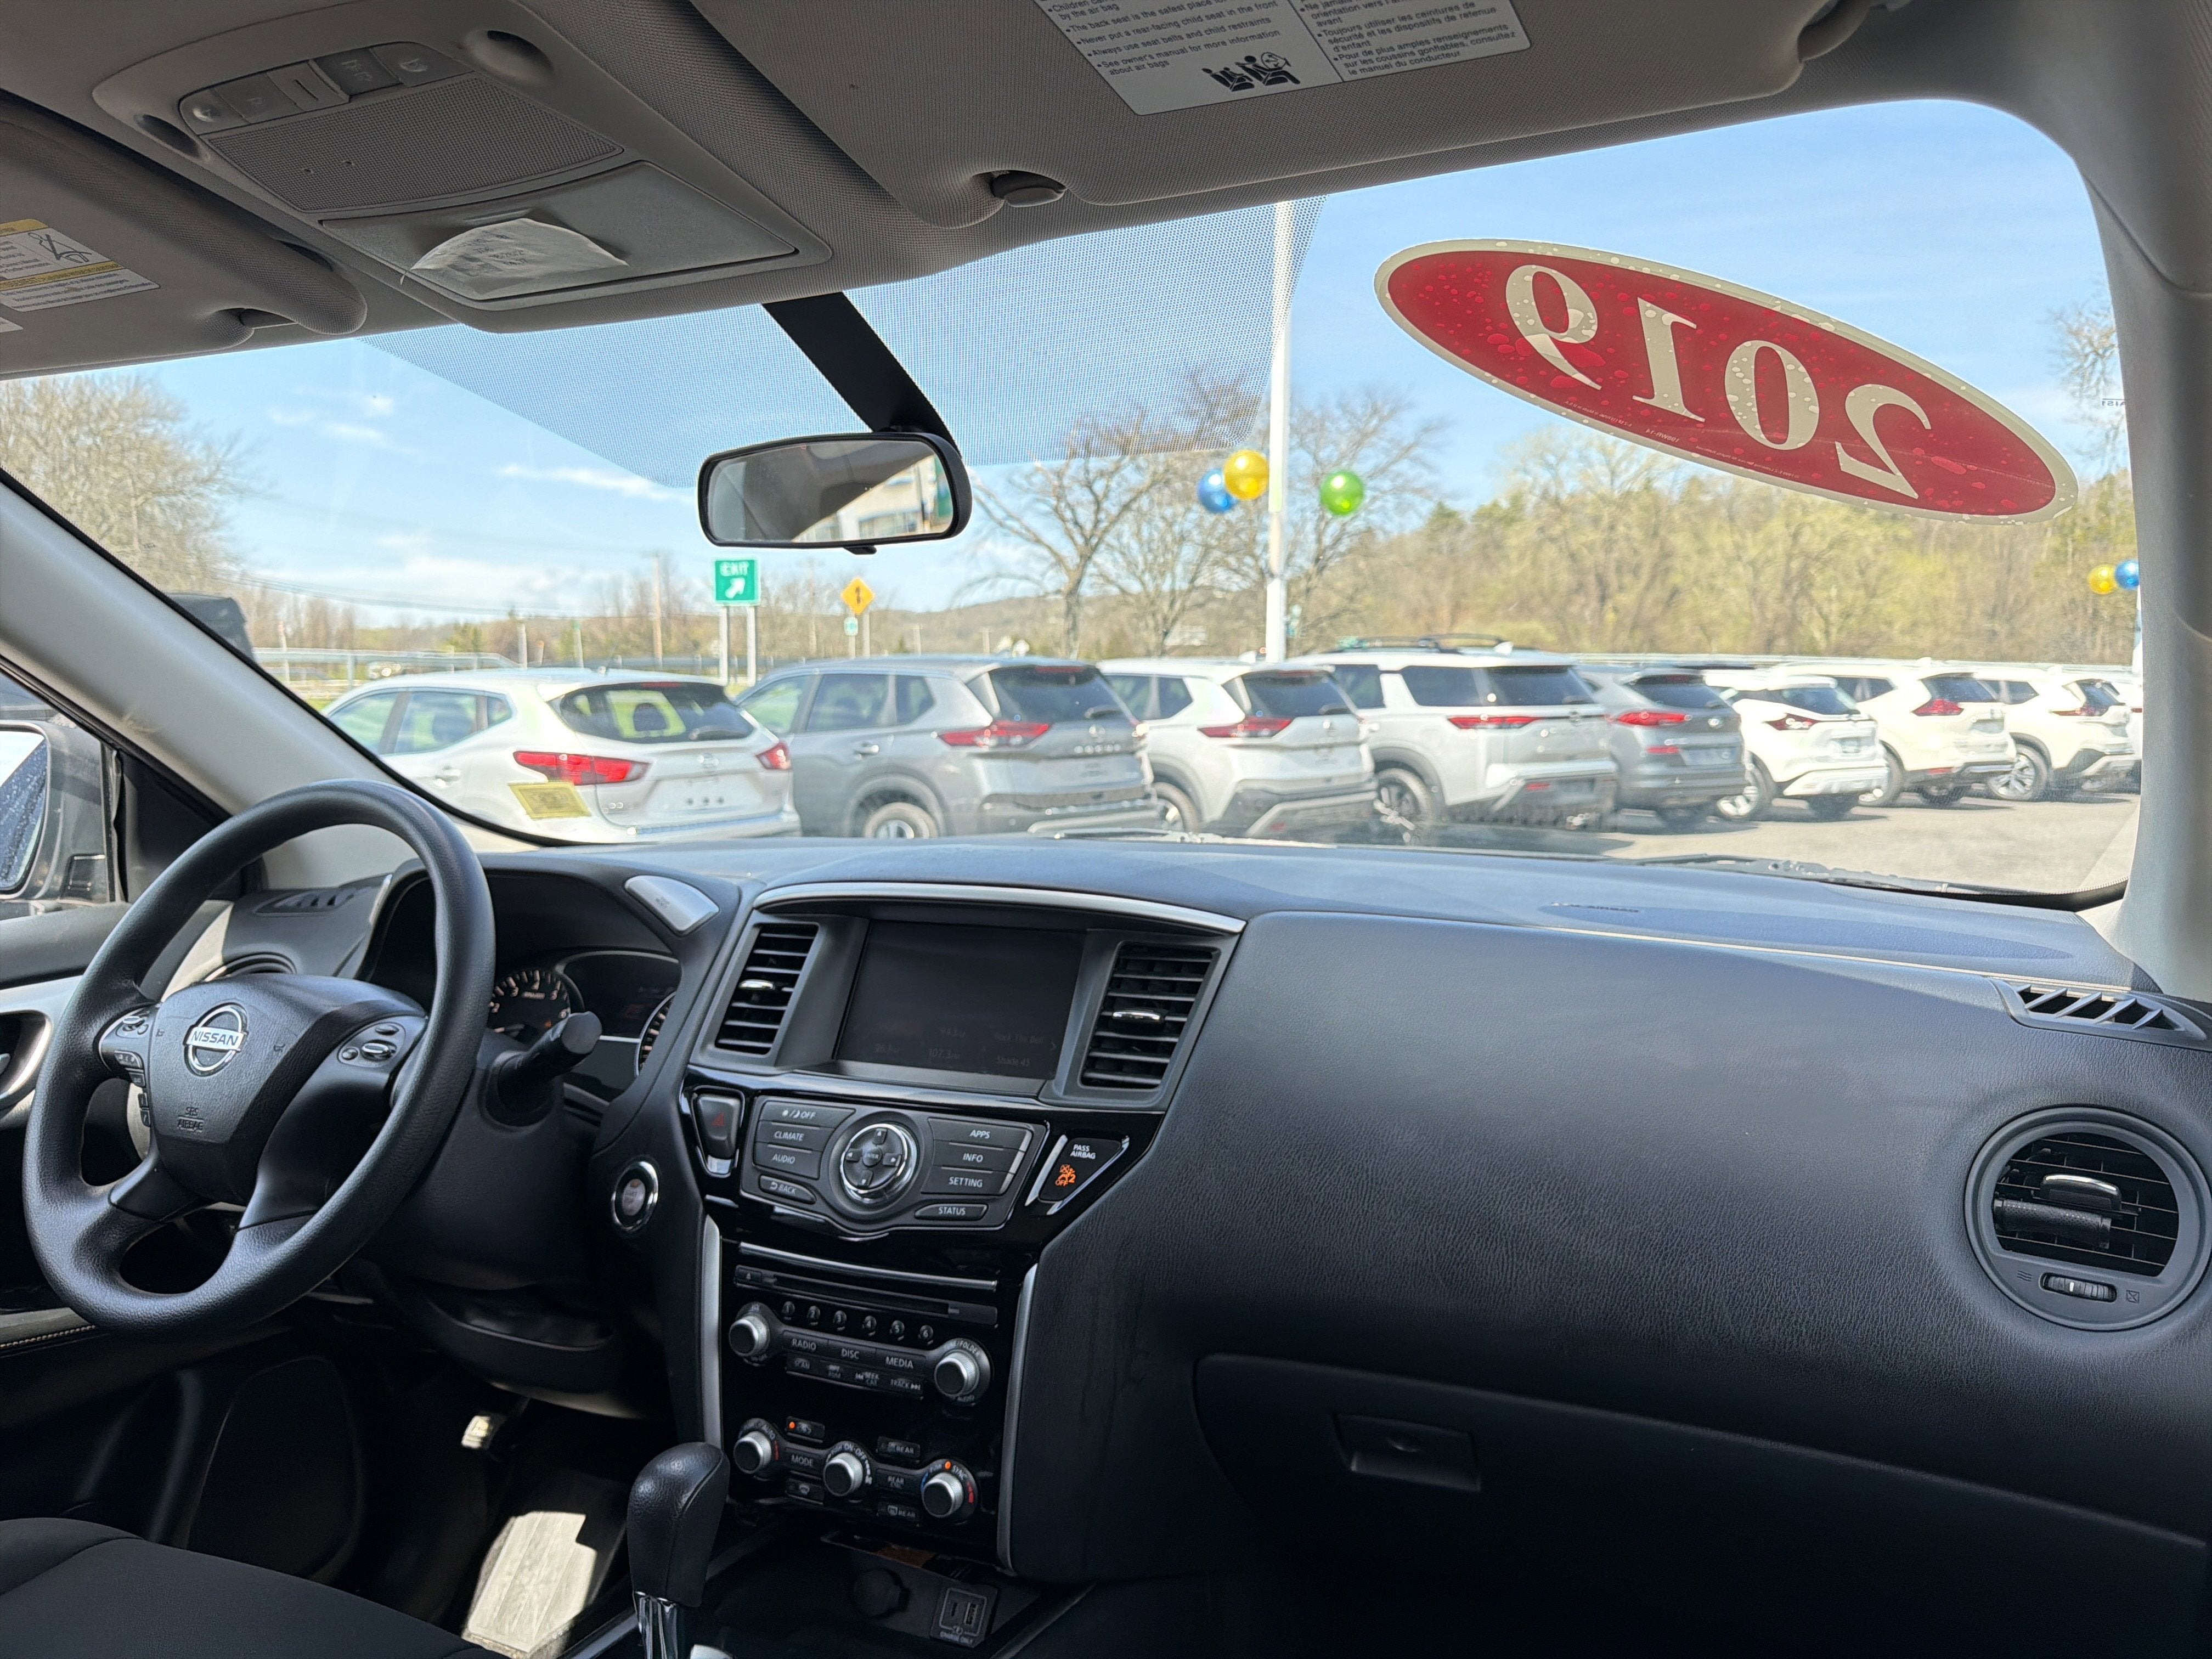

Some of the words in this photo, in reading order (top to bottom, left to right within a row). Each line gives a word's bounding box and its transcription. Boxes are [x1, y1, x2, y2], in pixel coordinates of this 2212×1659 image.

[1052, 1, 1090, 12] Children
[1088, 7, 1099, 15] air
[1305, 2, 1319, 11] Ne
[1311, 4, 1361, 19] orientation
[1362, 0, 1384, 9] vers
[1087, 20, 1110, 29] back
[1111, 16, 1130, 25] seat
[1142, 10, 1156, 18] the
[1158, 4, 1186, 15] safest
[1187, 0, 1212, 10] place
[1323, 24, 1363, 37] Toujours
[1364, 17, 1395, 28] utiliser
[1397, 13, 1413, 21] les
[1415, 5, 1460, 19] ceintures
[1463, 1, 1476, 9] de
[1081, 35, 1107, 44] Never
[1108, 32, 1124, 41] put
[1132, 20, 1181, 35] rear-facing
[1182, 15, 1204, 26] child
[1205, 11, 1226, 20] seat
[1237, 5, 1254, 14] the
[1254, 1, 1278, 10] front
[1316, 17, 1343, 27] avant
[1328, 32, 1364, 44] sécurité
[1366, 29, 1376, 37] et
[1395, 18, 1442, 32] dispositifs
[1444, 14, 1457, 22] de
[1459, 7, 1497, 20] retenue
[1092, 45, 1122, 56] Always
[1124, 42, 1140, 50] use
[1141, 38, 1160, 48] seat
[1161, 33, 1184, 43] belts
[1186, 30, 1203, 39] and
[1204, 25, 1227, 36] child
[1229, 16, 1272, 30] restraints
[1338, 52, 1362, 60] Pour
[1362, 48, 1374, 57] de
[1375, 44, 1395, 55] plus
[1397, 38, 1431, 50] amples
[1432, 24, 1509, 43] renseignements
[1101, 59, 1120, 68] See
[1121, 53, 1155, 66] owner's
[1156, 47, 1188, 59] manual
[1203, 40, 1227, 49] more
[1229, 29, 1280, 44] information
[1333, 40, 1372, 53] d'enfant
[1375, 50, 1416, 63] coussins
[1470, 31, 1516, 46] consultez
[1109, 65, 1133, 75] about
[1147, 60, 1170, 70] bags
[1359, 63, 1393, 74] manuel
[1409, 51, 1460, 65] conducteur
[192, 1030, 239, 1046] NISSAN
[801, 1111, 816, 1119] OFF
[774, 1130, 805, 1142] CLIMATE
[969, 1129, 991, 1139] APPS
[1073, 1144, 1090, 1152] PASS
[772, 1154, 796, 1164] AUDIO
[962, 1153, 984, 1163] INFO
[1070, 1150, 1096, 1160] AIRBAG
[948, 1176, 983, 1188] SETTING
[779, 1184, 797, 1195] BACK
[938, 1206, 966, 1216] STATUS
[792, 1338, 817, 1351] RADIO
[840, 1347, 860, 1359] DISC
[885, 1356, 914, 1370] MEDIA
[791, 1454, 814, 1467] MODE
